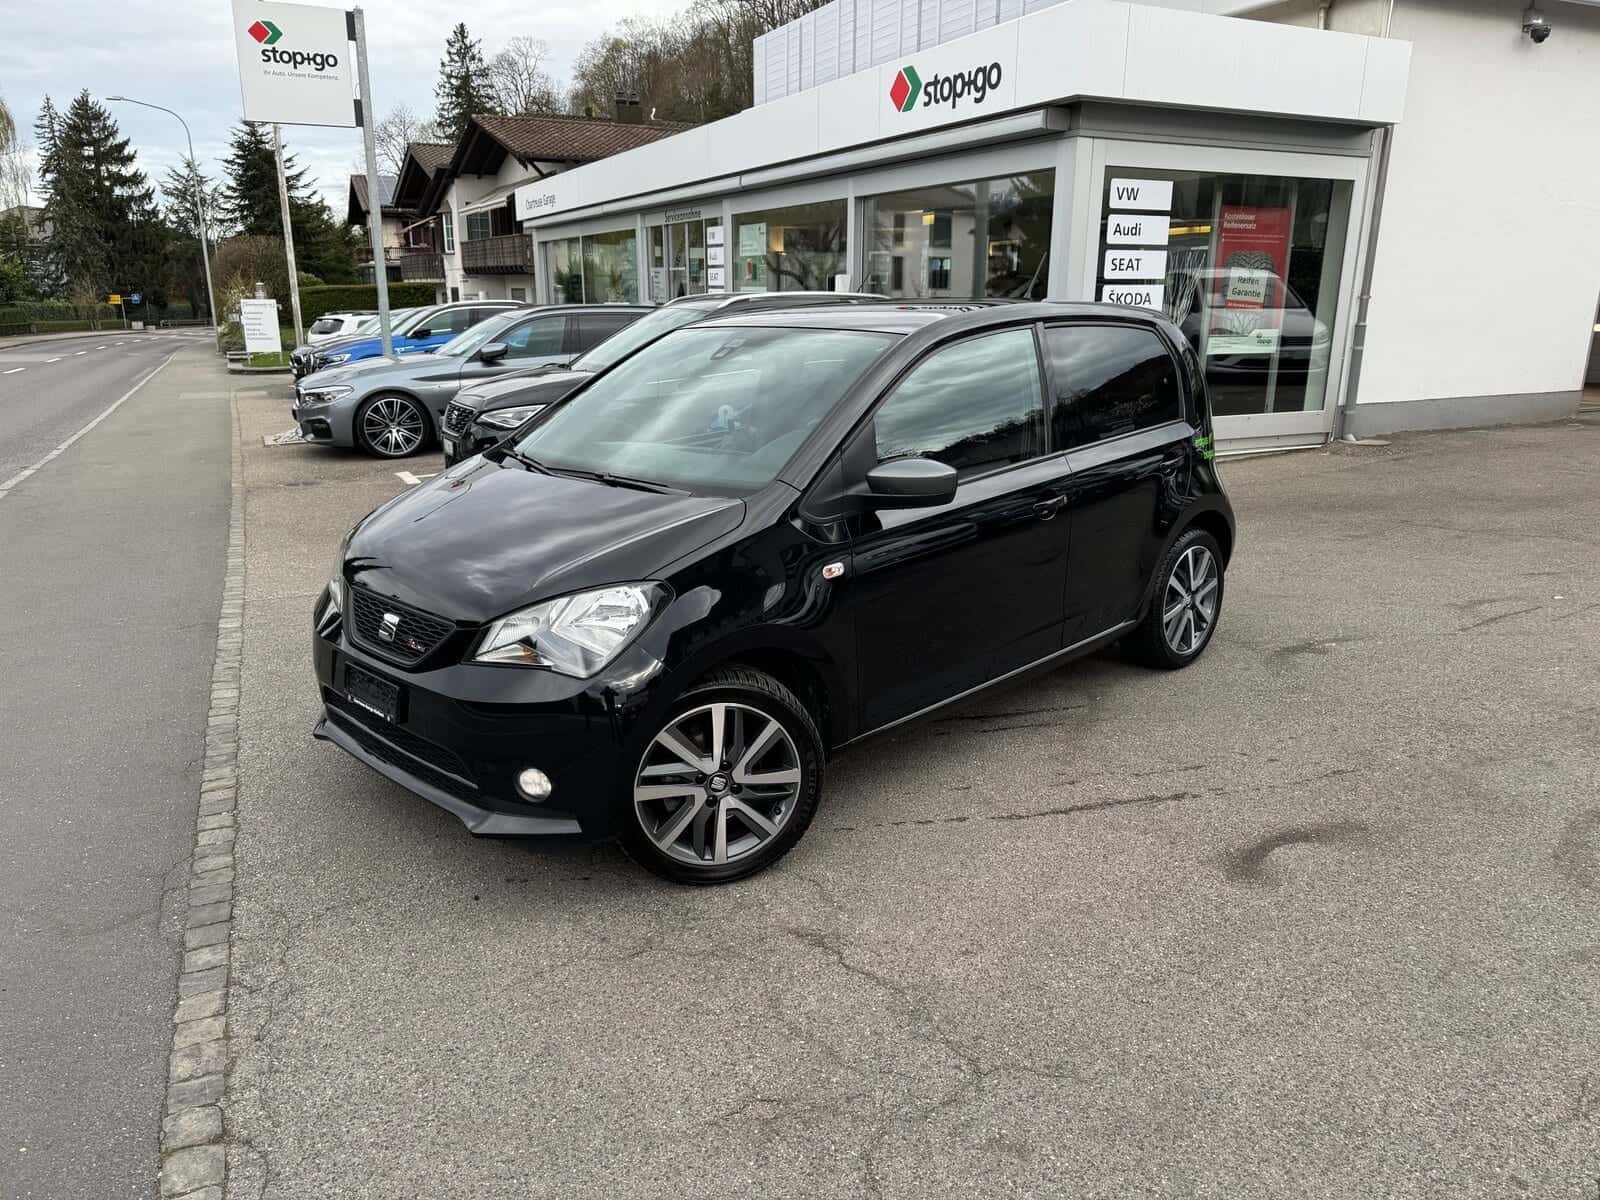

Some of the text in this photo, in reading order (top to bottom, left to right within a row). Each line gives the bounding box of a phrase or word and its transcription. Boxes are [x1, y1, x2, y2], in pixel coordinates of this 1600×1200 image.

[261, 46, 338, 71] stop+go
[922, 62, 1002, 109] stop+go
[1116, 186, 1140, 201] VW
[1112, 222, 1142, 237] Audi
[1110, 257, 1142, 272] SEAT
[1237, 275, 1260, 286] Reifen
[1108, 289, 1152, 305] ŠKODA
[1231, 286, 1262, 299] Garantie
